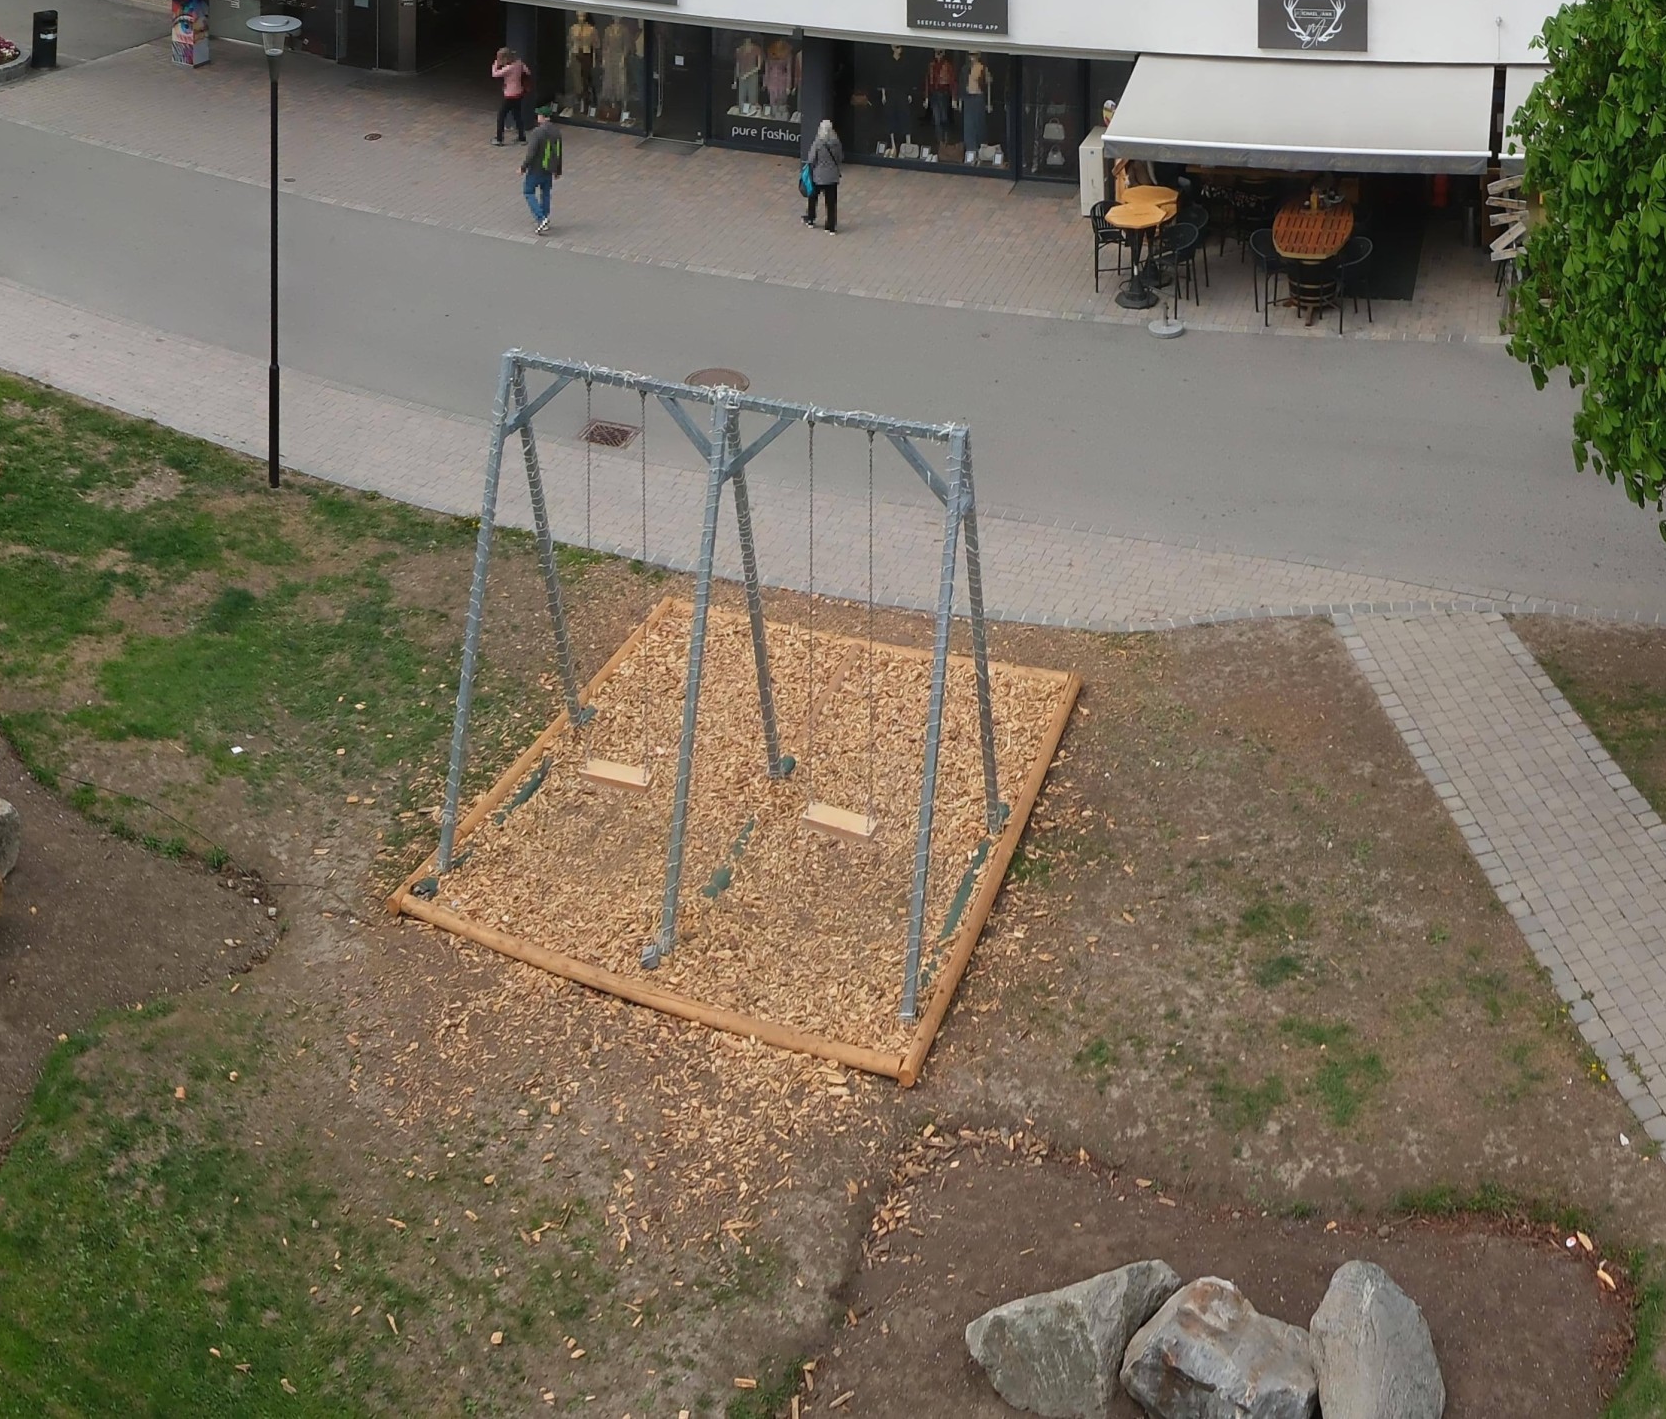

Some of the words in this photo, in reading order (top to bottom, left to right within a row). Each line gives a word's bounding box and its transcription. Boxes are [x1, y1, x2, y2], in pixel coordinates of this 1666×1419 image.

[944, 3, 973, 11] SEEFELD
[917, 19, 945, 27] SEEFELD
[948, 21, 983, 29] SHOPPING
[731, 126, 758, 137] pure
